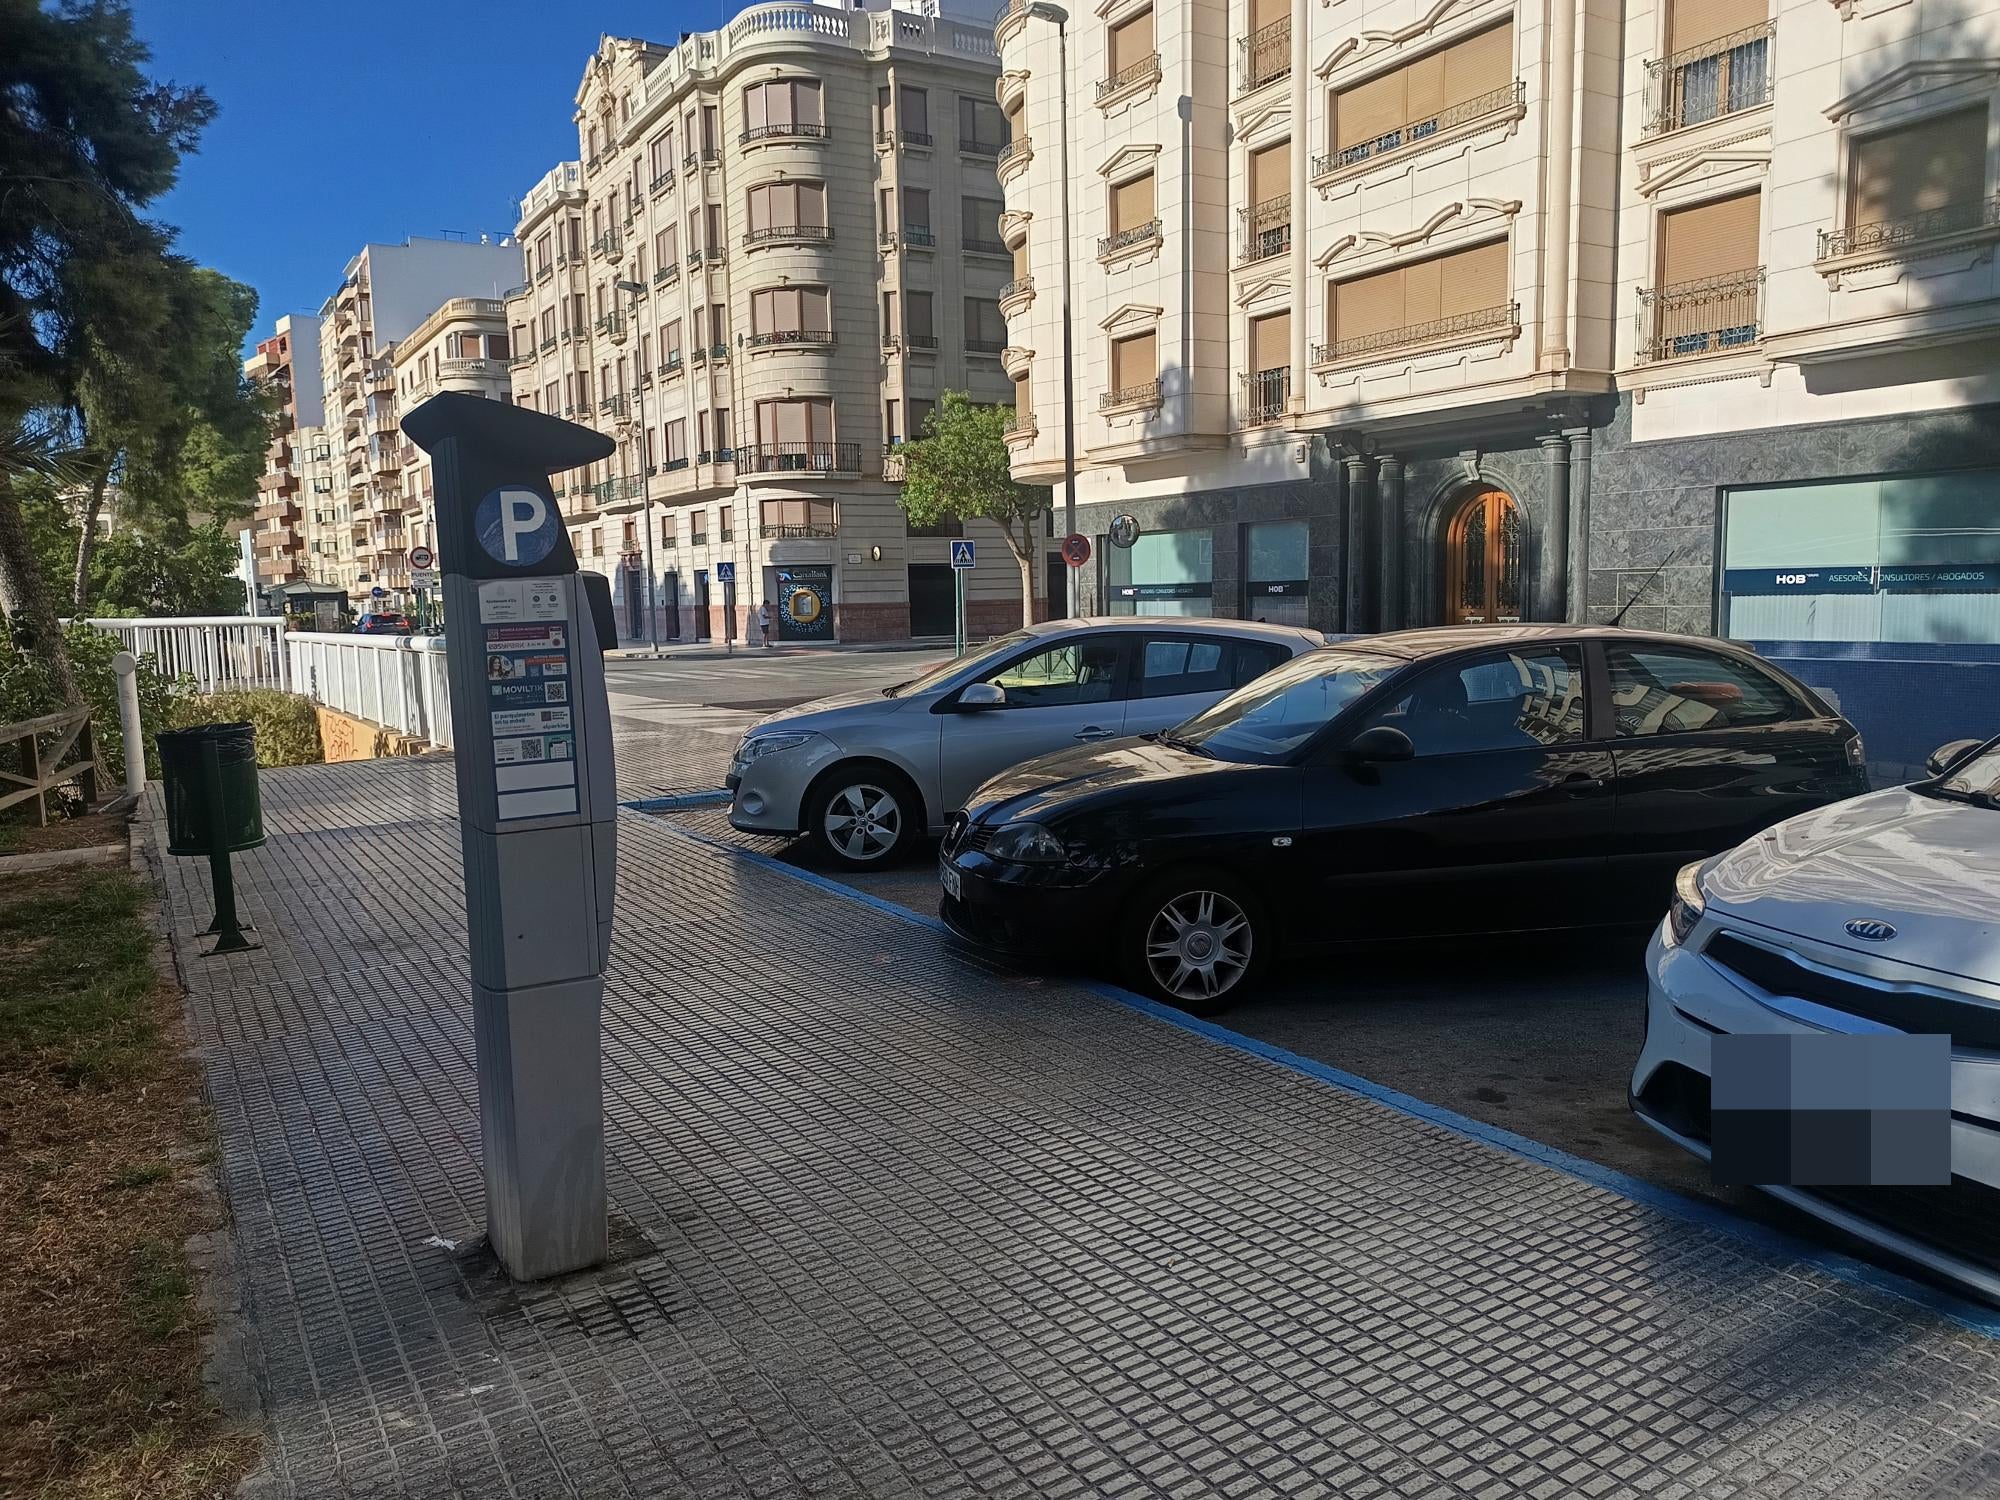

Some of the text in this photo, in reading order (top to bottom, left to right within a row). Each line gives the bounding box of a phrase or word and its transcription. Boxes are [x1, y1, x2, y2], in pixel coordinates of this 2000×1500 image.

[500, 491, 547, 561] P
[1776, 574, 1806, 585] HOB
[1828, 573, 1868, 582] ASESORES
[1876, 572, 1930, 583] ONSULTORES
[1937, 571, 1985, 581] ABOGADOS
[1122, 588, 1134, 596] HOB
[1268, 585, 1284, 593] HOB
[503, 685, 543, 694] MOVILTIK
[1850, 920, 1887, 936] KIA
